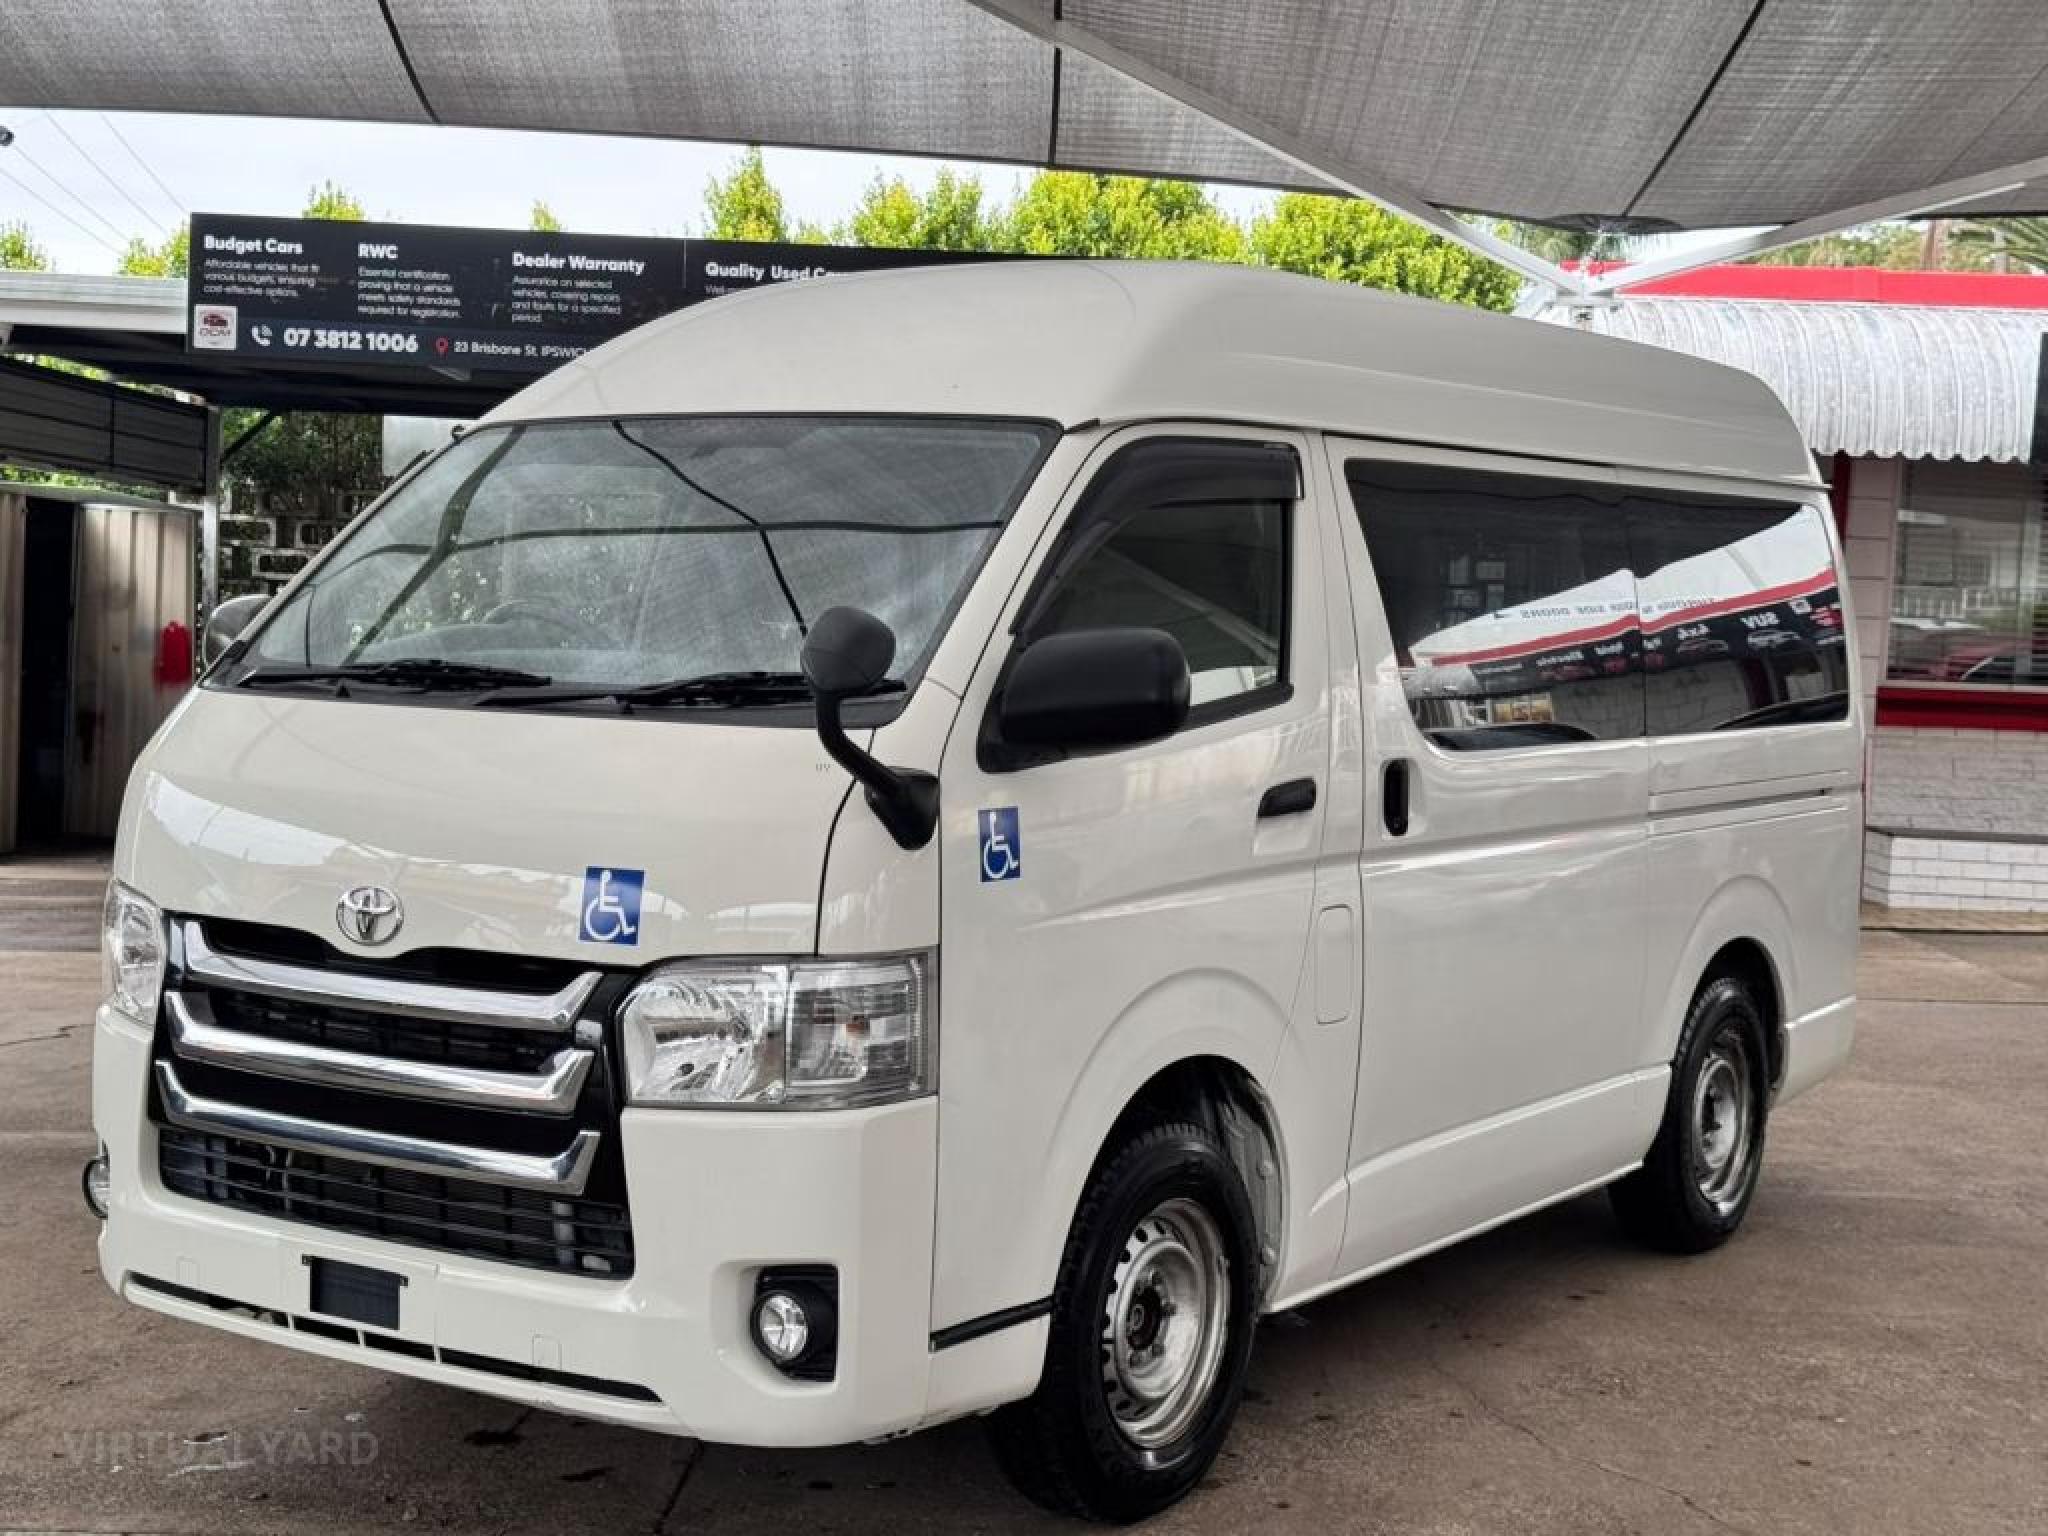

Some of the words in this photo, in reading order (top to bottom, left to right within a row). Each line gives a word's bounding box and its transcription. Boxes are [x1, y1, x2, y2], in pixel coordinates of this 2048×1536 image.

[203, 234, 263, 255] Budget
[265, 237, 304, 255] Cars
[358, 242, 398, 259] RWC
[253, 262, 289, 273] vehicles
[290, 263, 309, 273] that
[512, 251, 566, 269] Dealer
[568, 255, 646, 276] Warranty
[358, 265, 396, 277] Essential
[705, 261, 765, 282] Quality
[771, 265, 811, 281] Used
[204, 273, 235, 281] various
[278, 276, 315, 288] ensuring
[357, 281, 392, 292] proving
[393, 281, 411, 291] that
[422, 283, 454, 293] vehicle
[512, 275, 558, 287] Assurance
[559, 279, 573, 287] on
[574, 279, 613, 289] selected
[357, 293, 385, 302] meets
[387, 294, 414, 306] safety
[415, 296, 461, 307] standards
[551, 291, 589, 303] covering
[357, 305, 395, 317] required
[397, 306, 409, 316] for
[512, 301, 531, 309] and
[557, 302, 569, 312] for
[283, 327, 311, 347] 07
[313, 329, 363, 350] 3812
[366, 331, 419, 353] 1006
[454, 341, 469, 353] 23
[471, 341, 521, 355] Brisbane
[541, 345, 590, 358] IPSWIC
